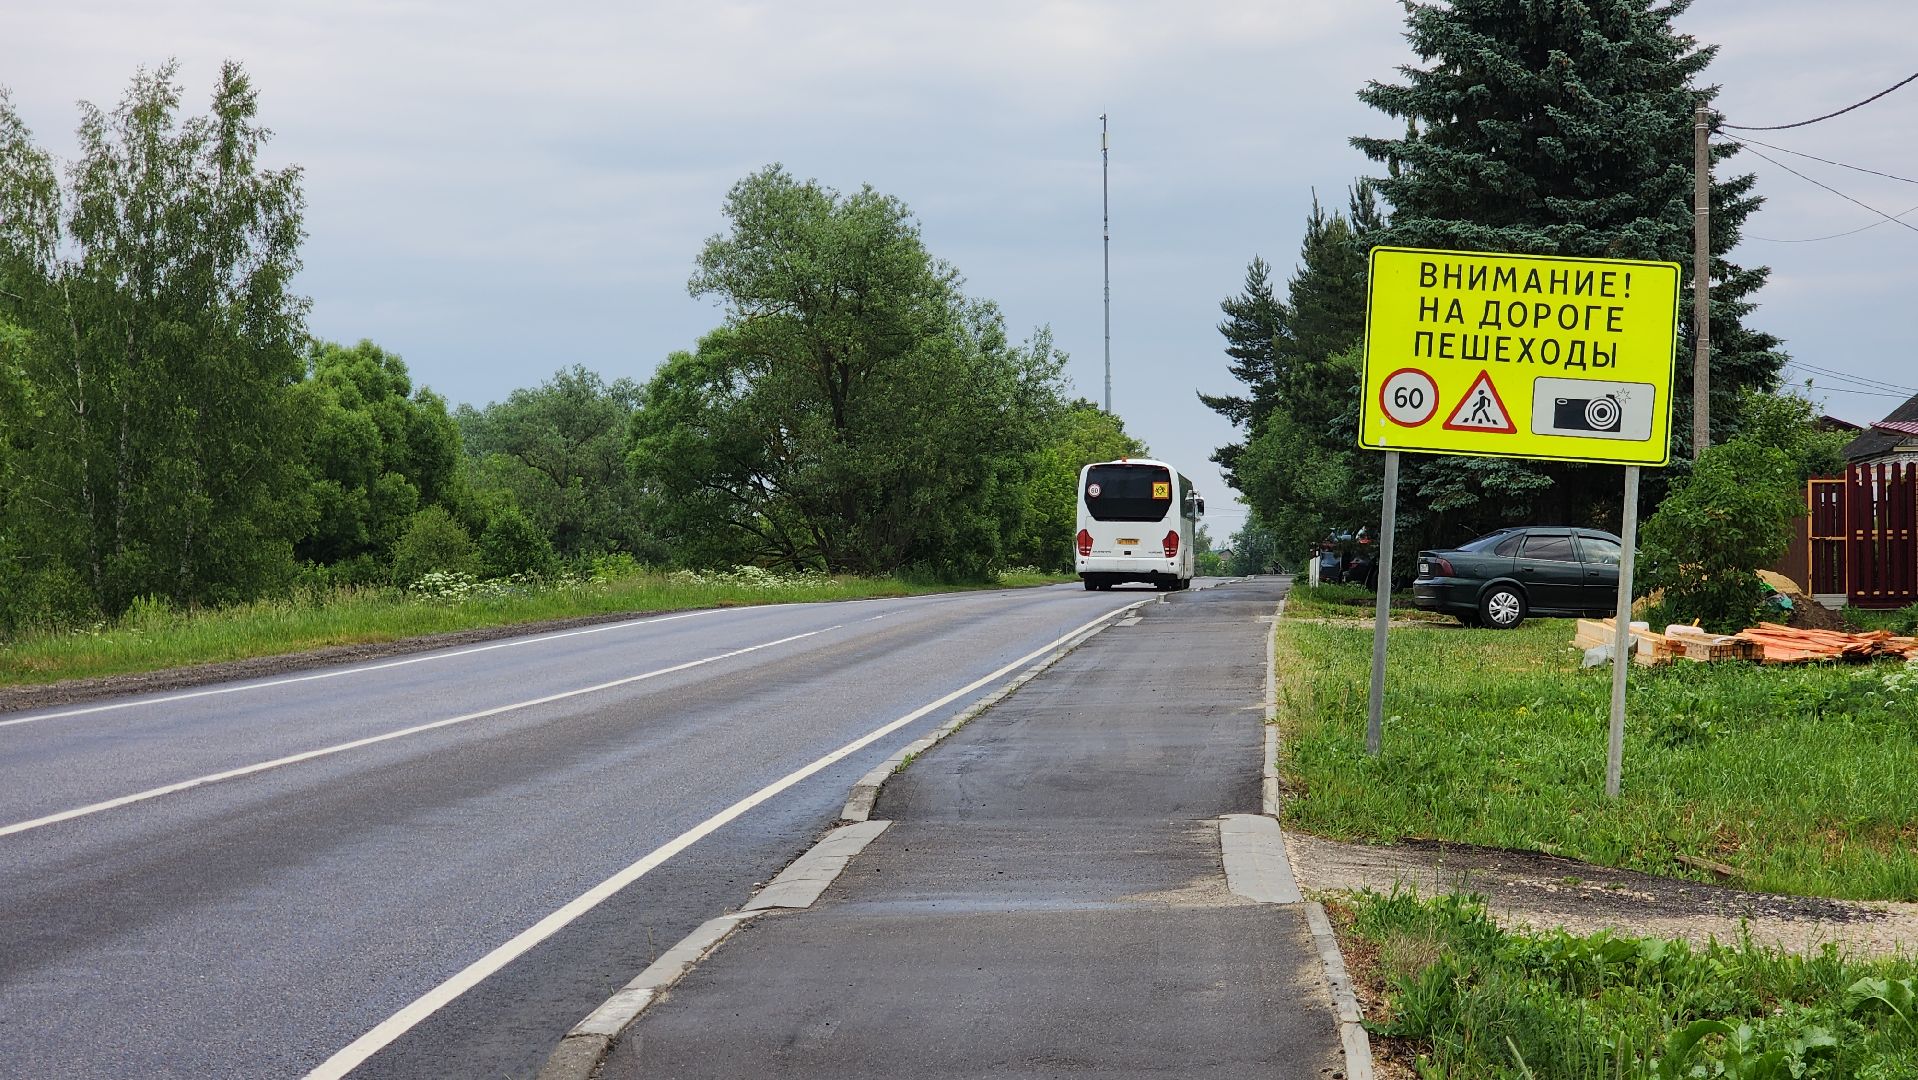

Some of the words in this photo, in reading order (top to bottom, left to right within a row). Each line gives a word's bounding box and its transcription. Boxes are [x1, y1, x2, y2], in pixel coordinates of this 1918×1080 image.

[1419, 261, 1631, 298] ВНИМАНИЕ!
[1418, 296, 1464, 324] НА
[1479, 300, 1624, 332] ДОРОГЕ
[1414, 331, 1617, 371] ПЕШЕХОДЫ
[1394, 386, 1423, 410] 60
